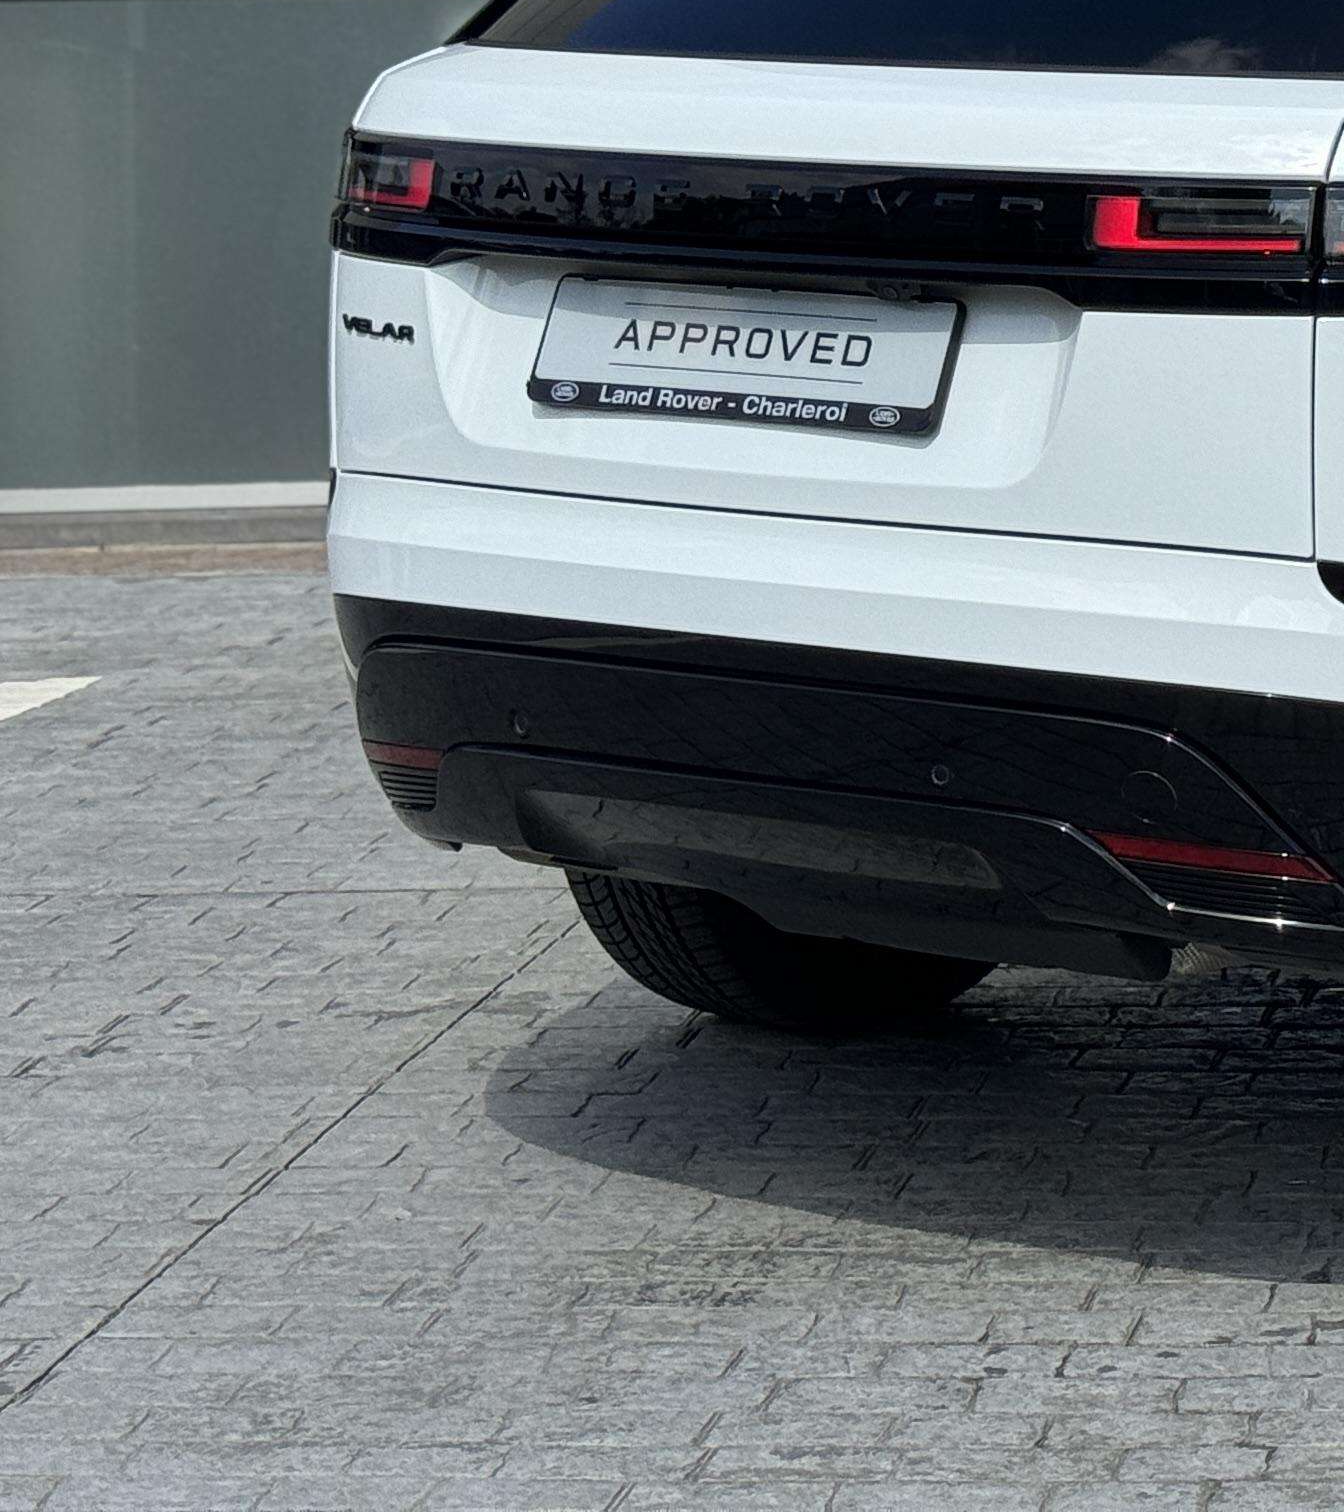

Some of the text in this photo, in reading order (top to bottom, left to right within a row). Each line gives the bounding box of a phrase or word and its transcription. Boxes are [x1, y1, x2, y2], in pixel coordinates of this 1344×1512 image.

[342, 313, 415, 345] VELAR
[613, 318, 873, 368] APPROVED
[597, 382, 652, 407] Land
[656, 389, 723, 413] Rover
[742, 393, 848, 423] Charleroi
